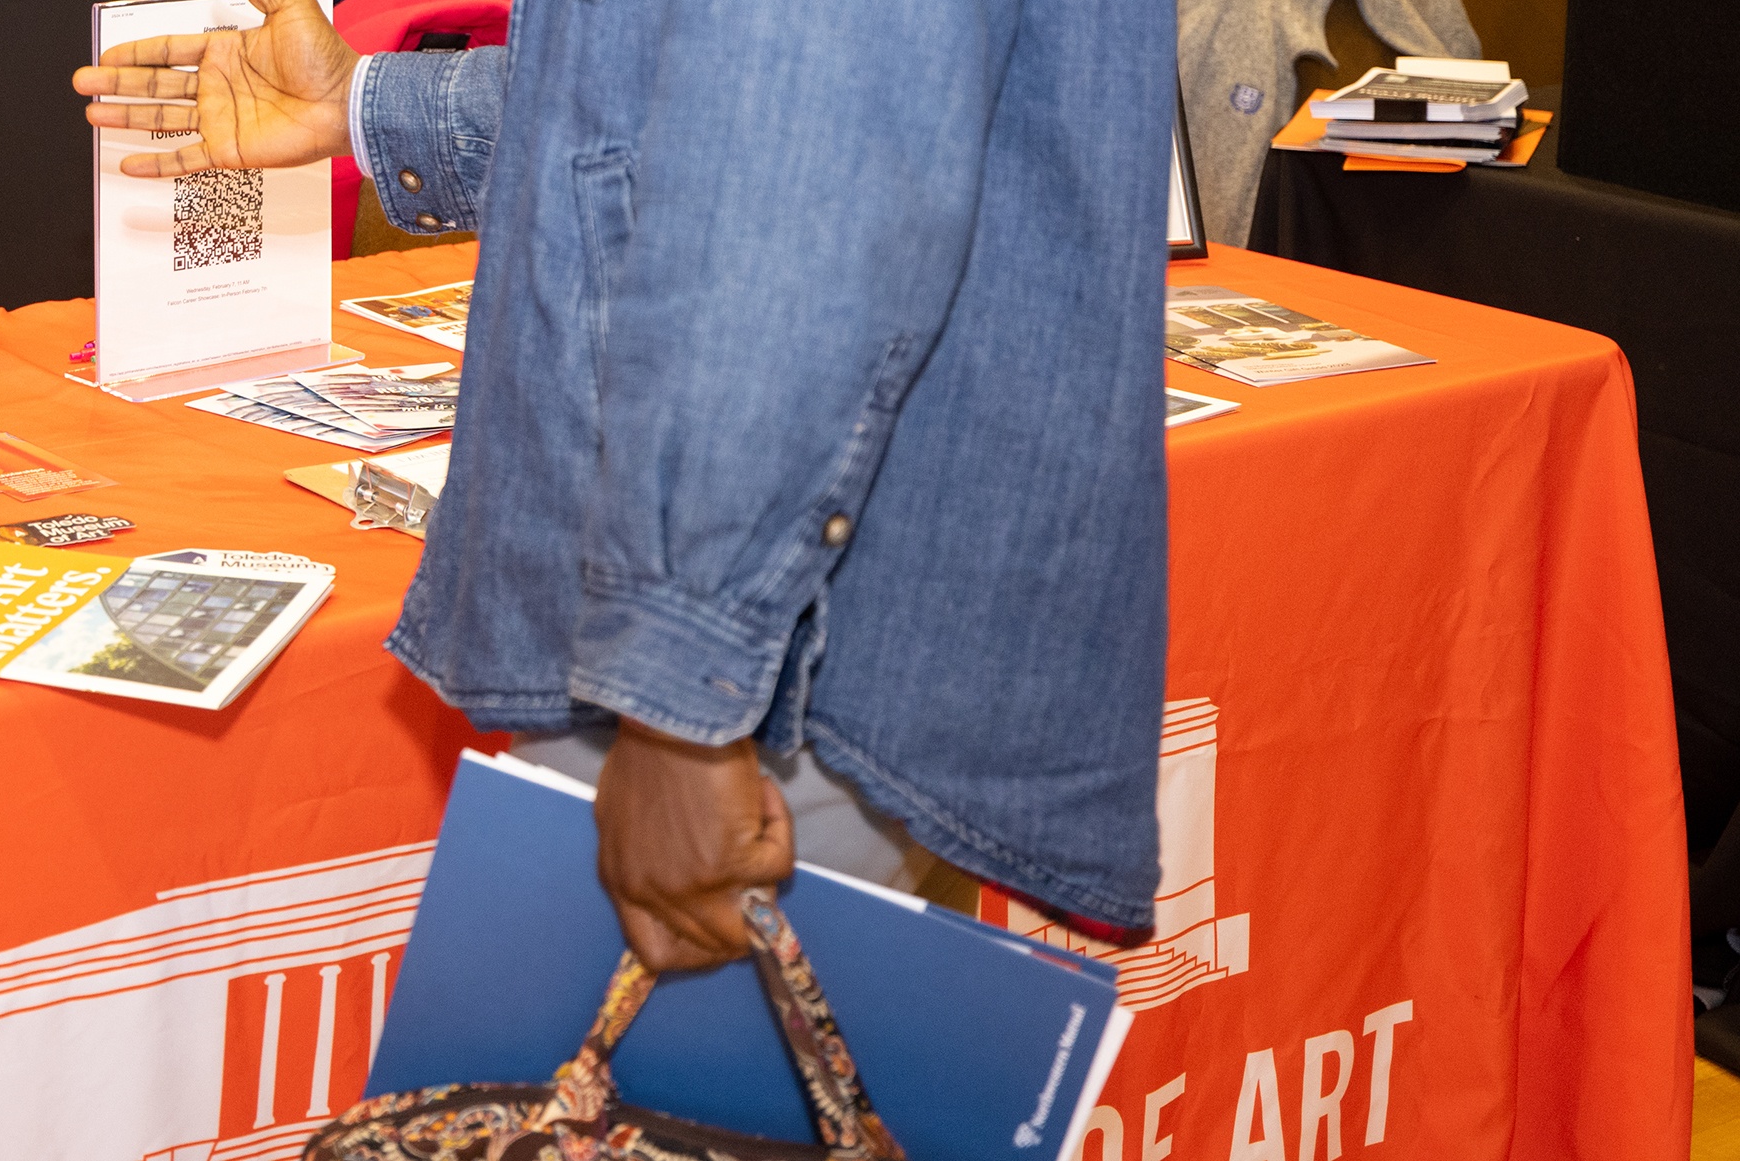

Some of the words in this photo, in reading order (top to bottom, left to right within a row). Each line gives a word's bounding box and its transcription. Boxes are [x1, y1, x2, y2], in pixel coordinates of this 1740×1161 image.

[374, 384, 431, 394] READY
[28, 515, 99, 531] Toledo
[40, 519, 130, 539] Museum
[50, 533, 74, 544] of
[76, 529, 110, 542] Art
[222, 552, 291, 562] Toledo
[221, 560, 317, 570] Museum
[1229, 999, 1413, 1161] ART
